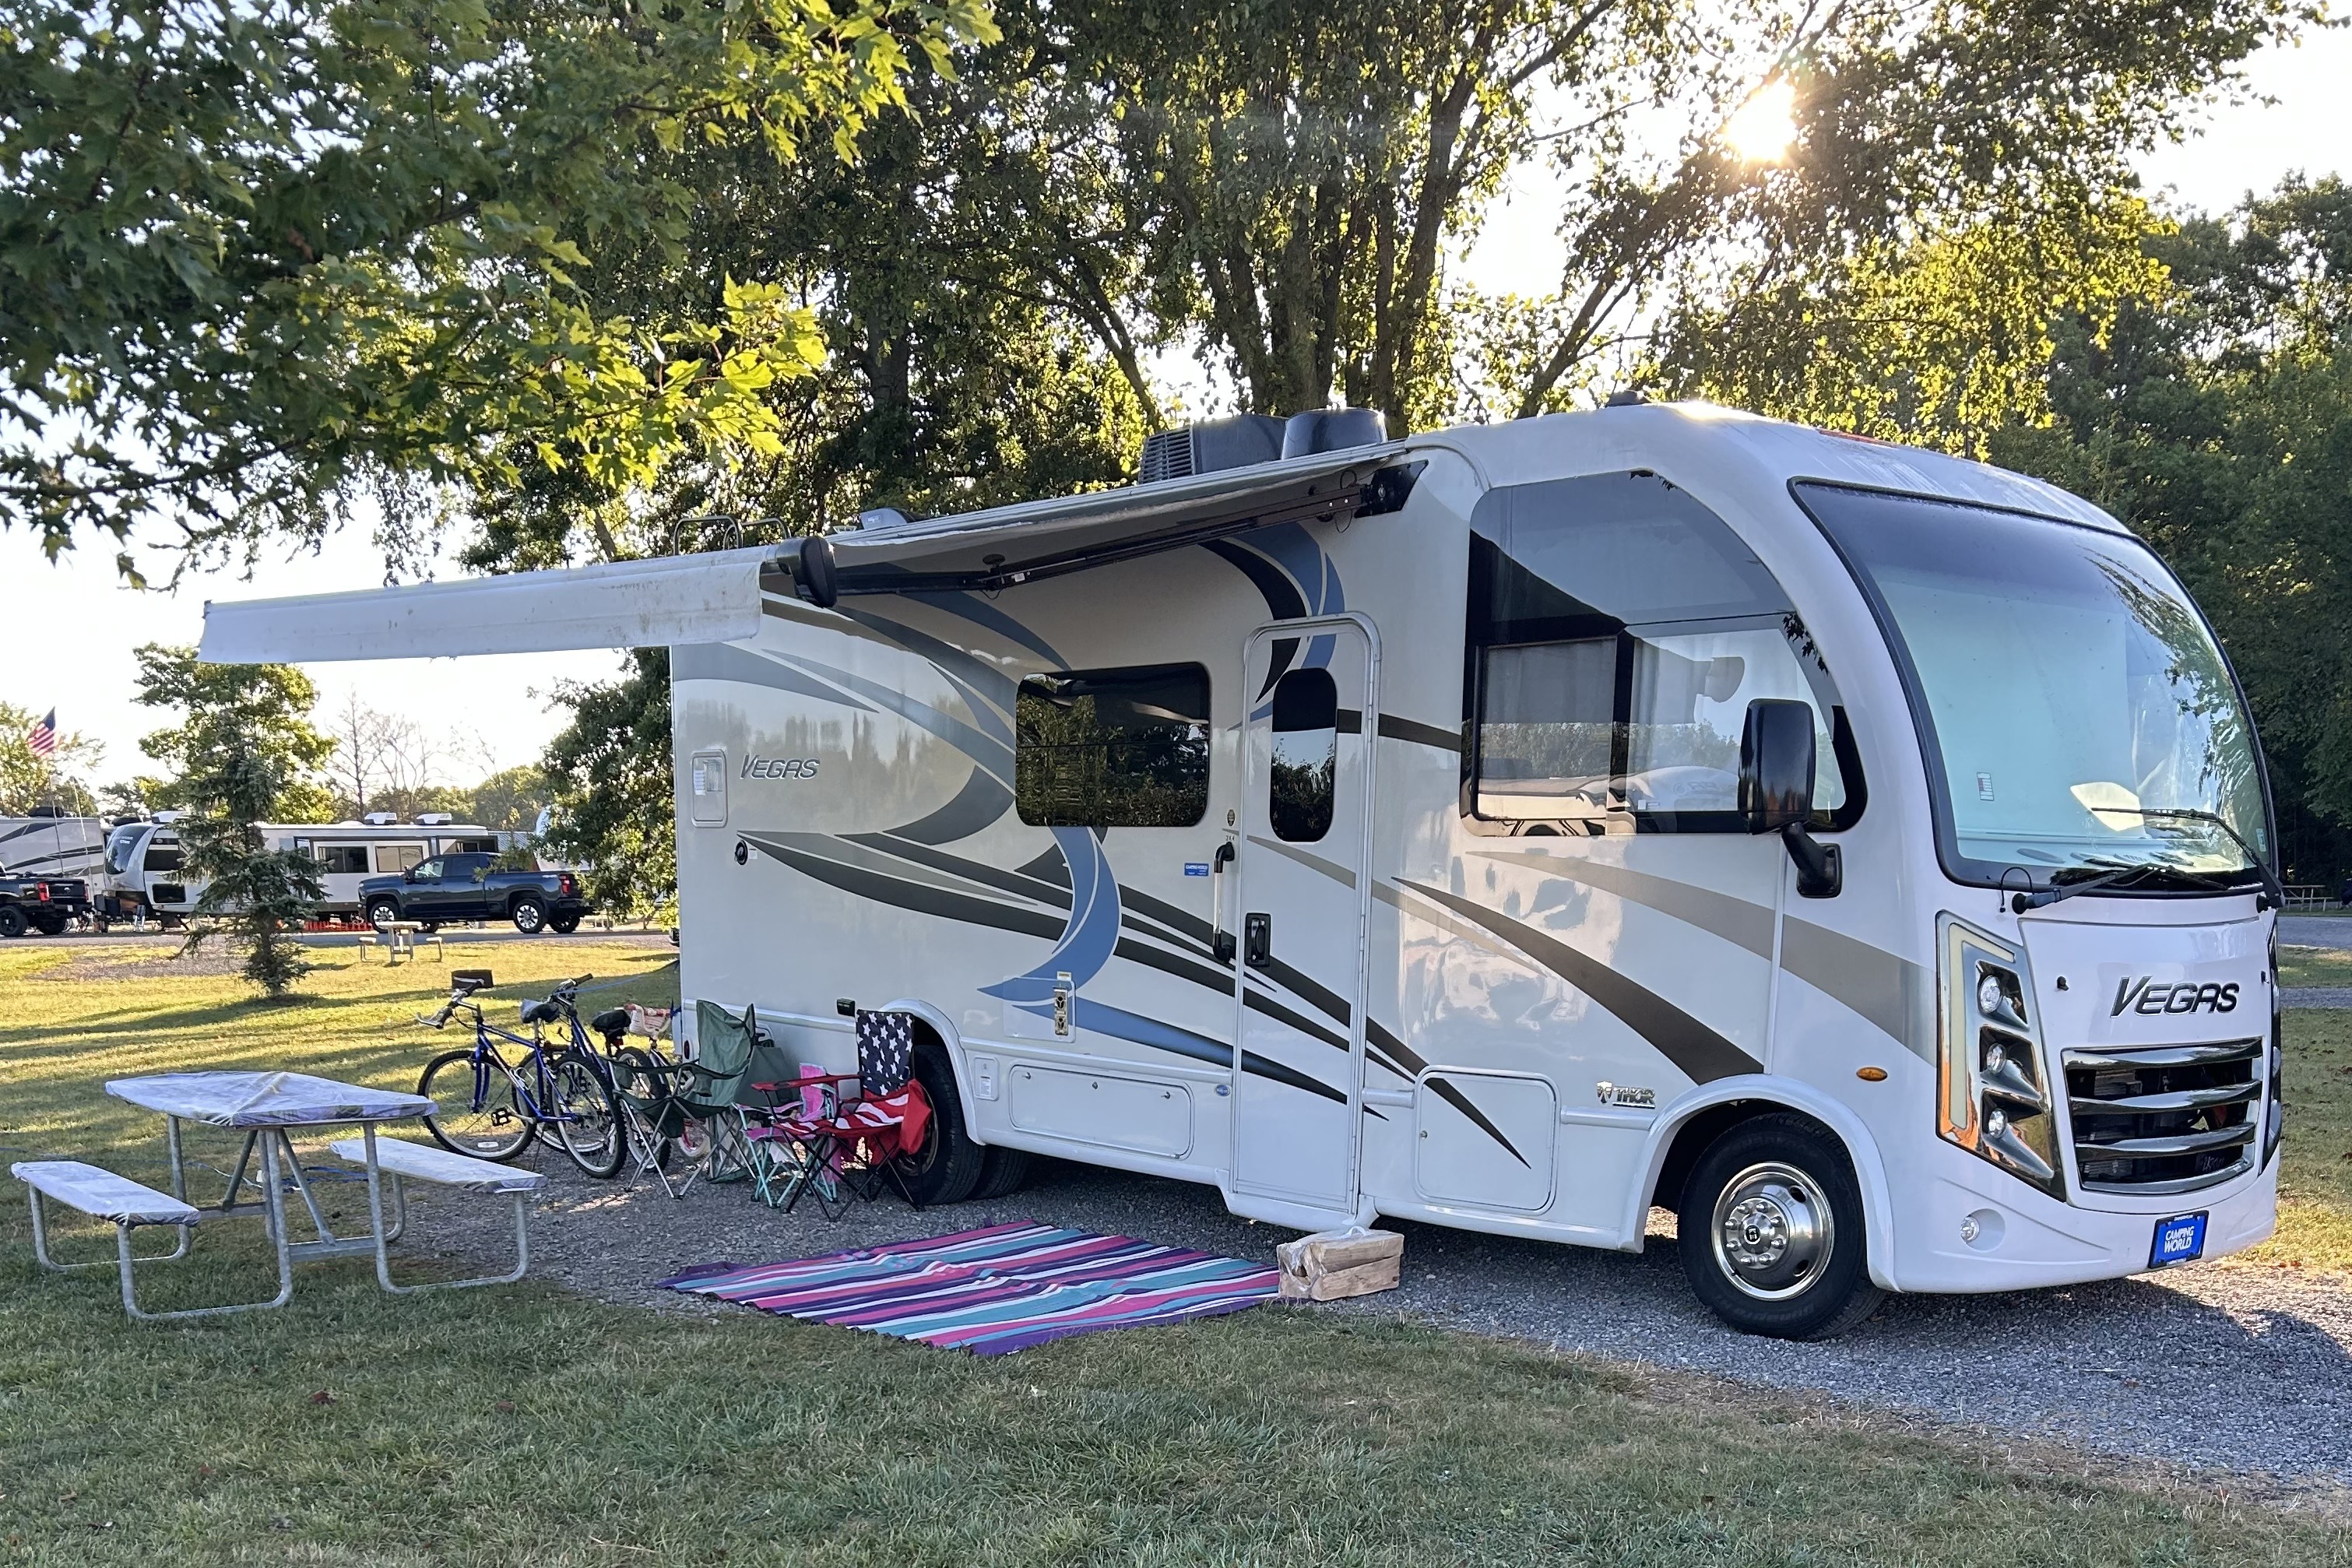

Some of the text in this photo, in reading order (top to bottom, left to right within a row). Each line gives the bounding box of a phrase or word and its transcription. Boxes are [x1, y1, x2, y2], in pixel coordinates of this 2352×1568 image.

[740, 754, 821, 780] VEGAS
[2110, 976, 2240, 1018] VEGAS
[1613, 1085, 1655, 1105] THOR
[2165, 1225, 2195, 1241] CAMPING
[2164, 1236, 2192, 1253] WORLD
